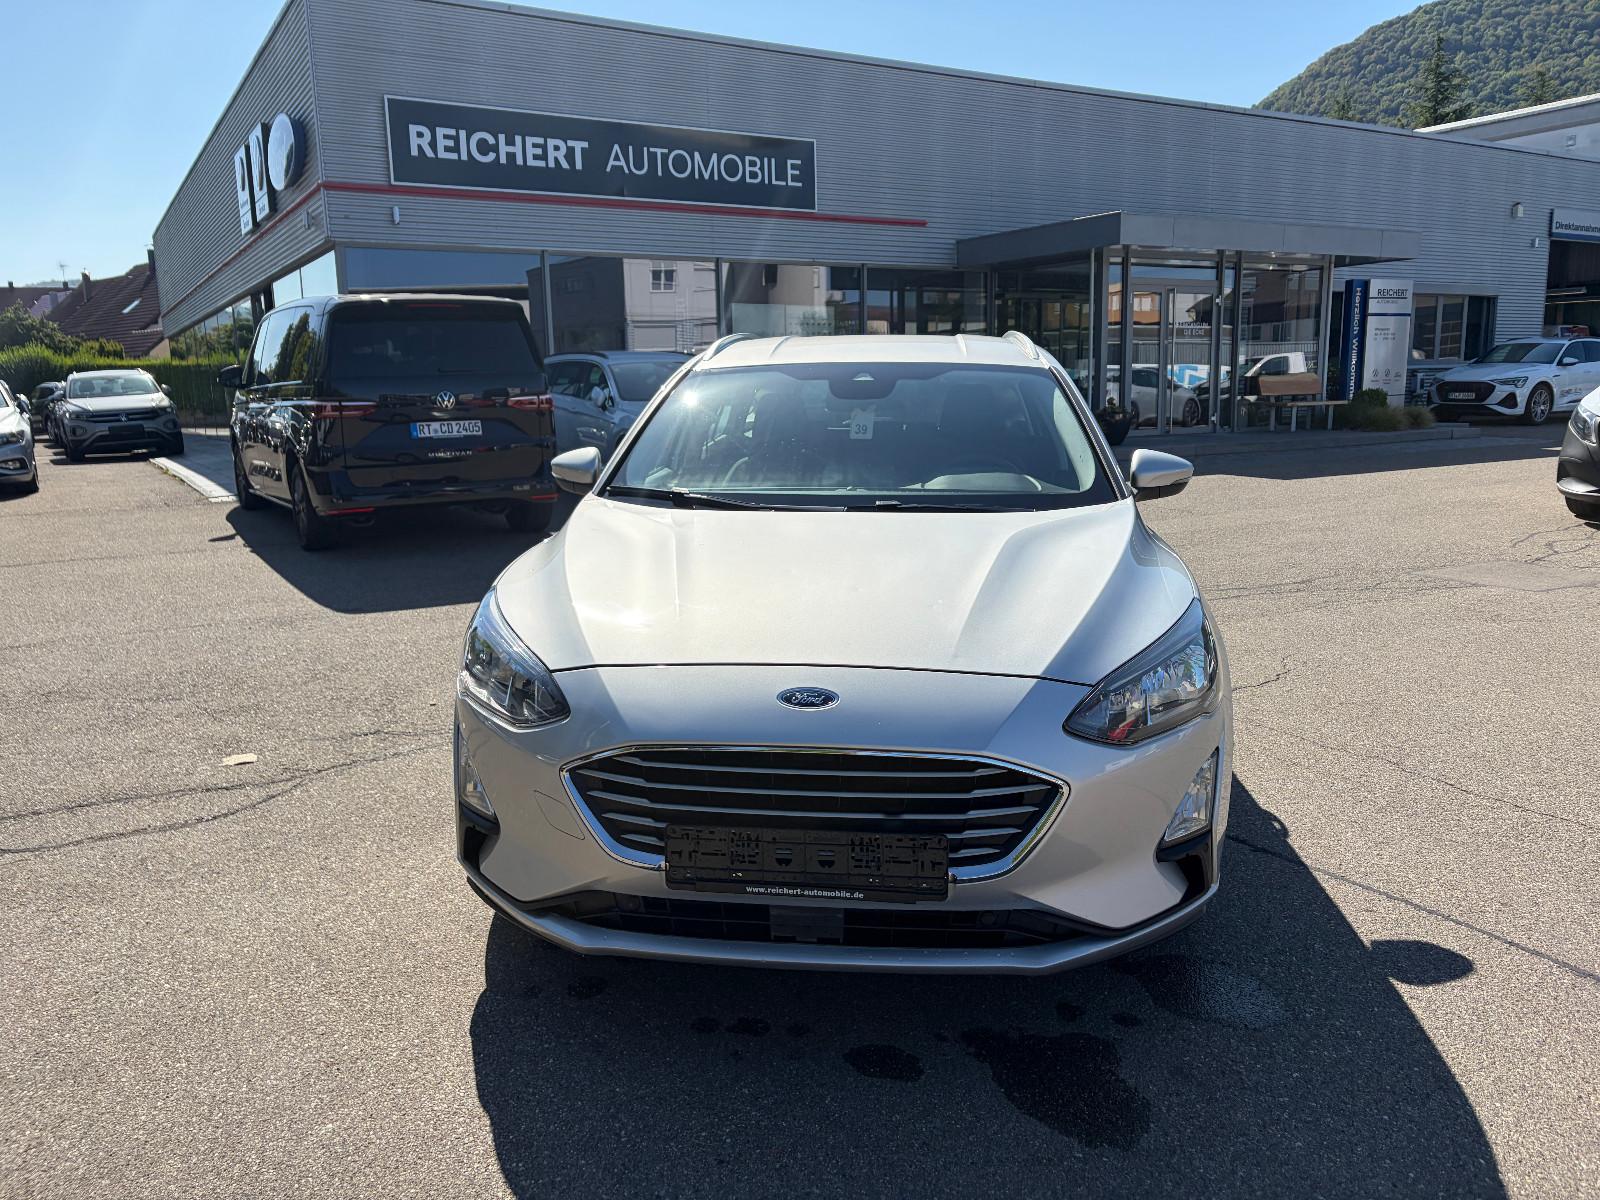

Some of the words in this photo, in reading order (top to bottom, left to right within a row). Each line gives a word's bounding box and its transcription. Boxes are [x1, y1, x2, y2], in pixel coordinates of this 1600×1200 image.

[408, 123, 589, 171] REICHERT
[605, 143, 803, 188] AUTOMOBILE
[1555, 221, 1600, 232] Direktannahm
[1377, 288, 1408, 297] REICHERT
[1353, 287, 1362, 334] Herzlich
[418, 424, 431, 436] RT
[440, 422, 454, 434] CD
[456, 421, 480, 434] 2405
[855, 423, 867, 435] 39
[791, 691, 826, 704] Ford
[745, 886, 864, 899] www.reichert-automobile.de
